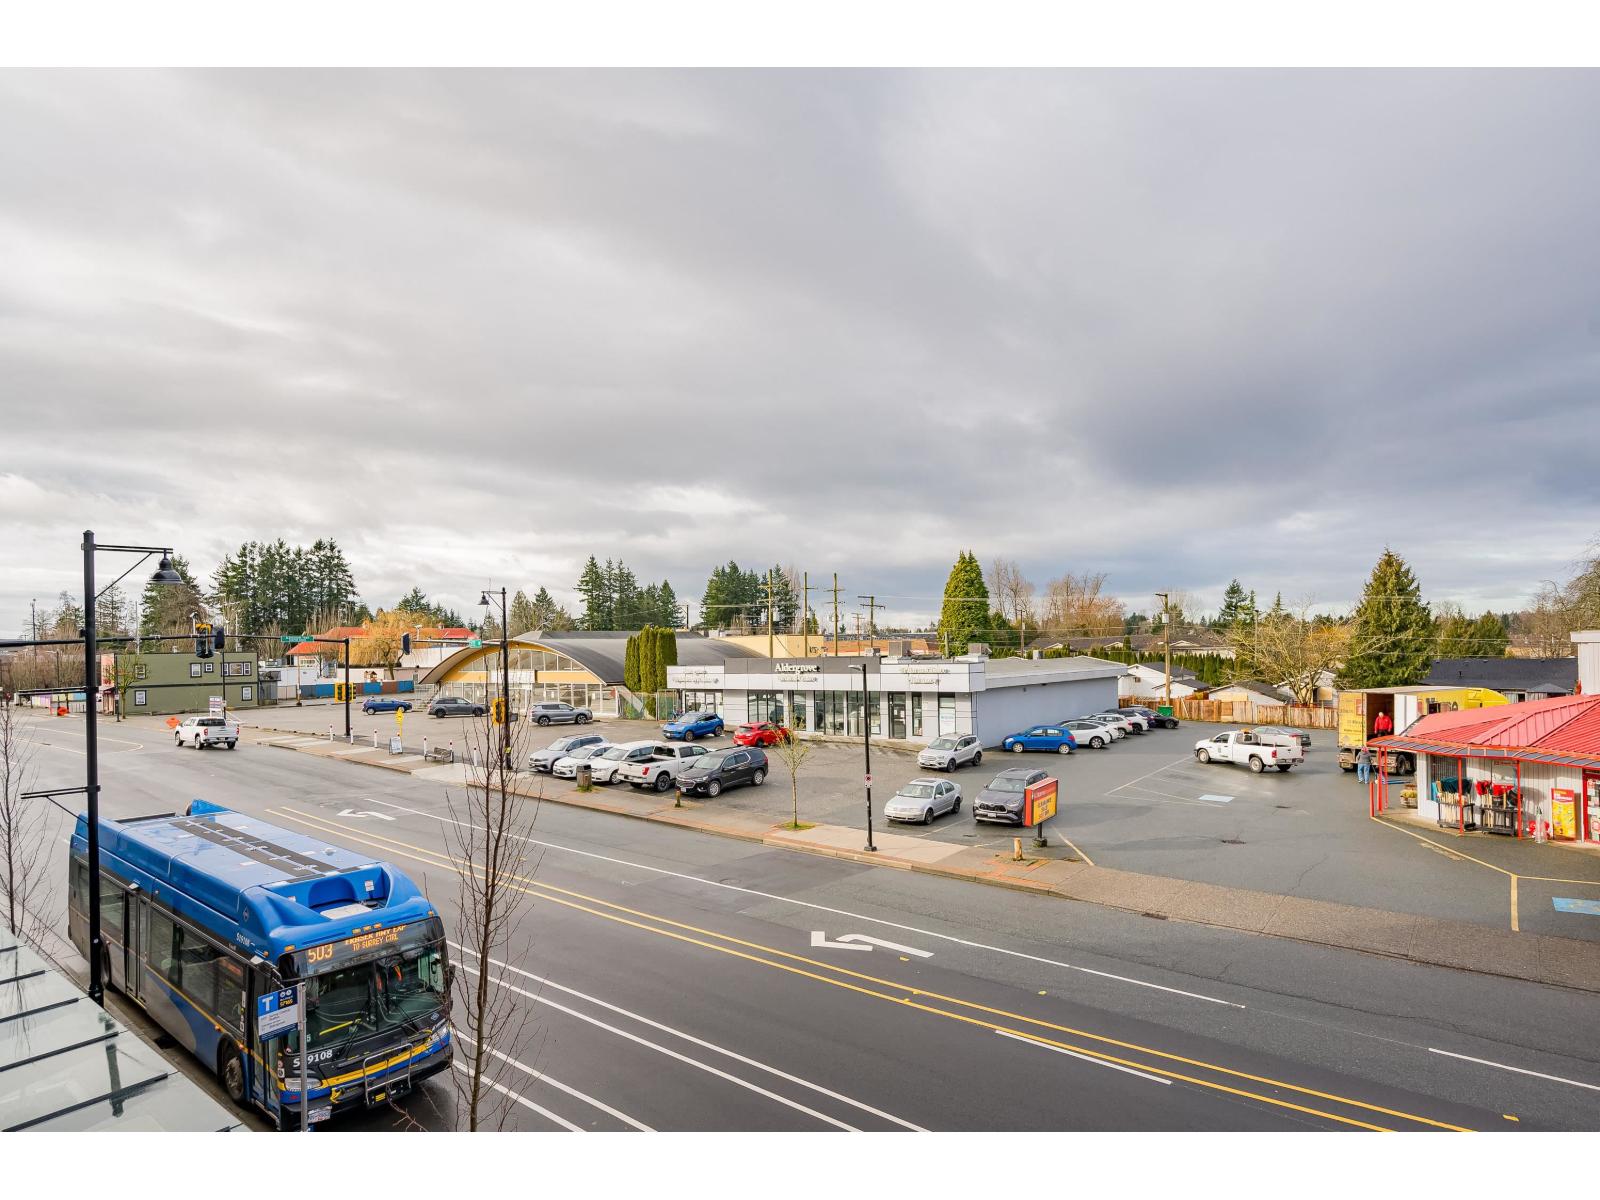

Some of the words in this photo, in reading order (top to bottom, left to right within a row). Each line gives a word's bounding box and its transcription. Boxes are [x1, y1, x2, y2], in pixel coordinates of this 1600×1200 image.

[775, 663, 817, 673] Aldergrove
[353, 942, 360, 951] TO
[362, 937, 384, 948] SURREY
[307, 943, 334, 963] 503
[262, 995, 273, 1011] T
[292, 1049, 333, 1068] S9108
